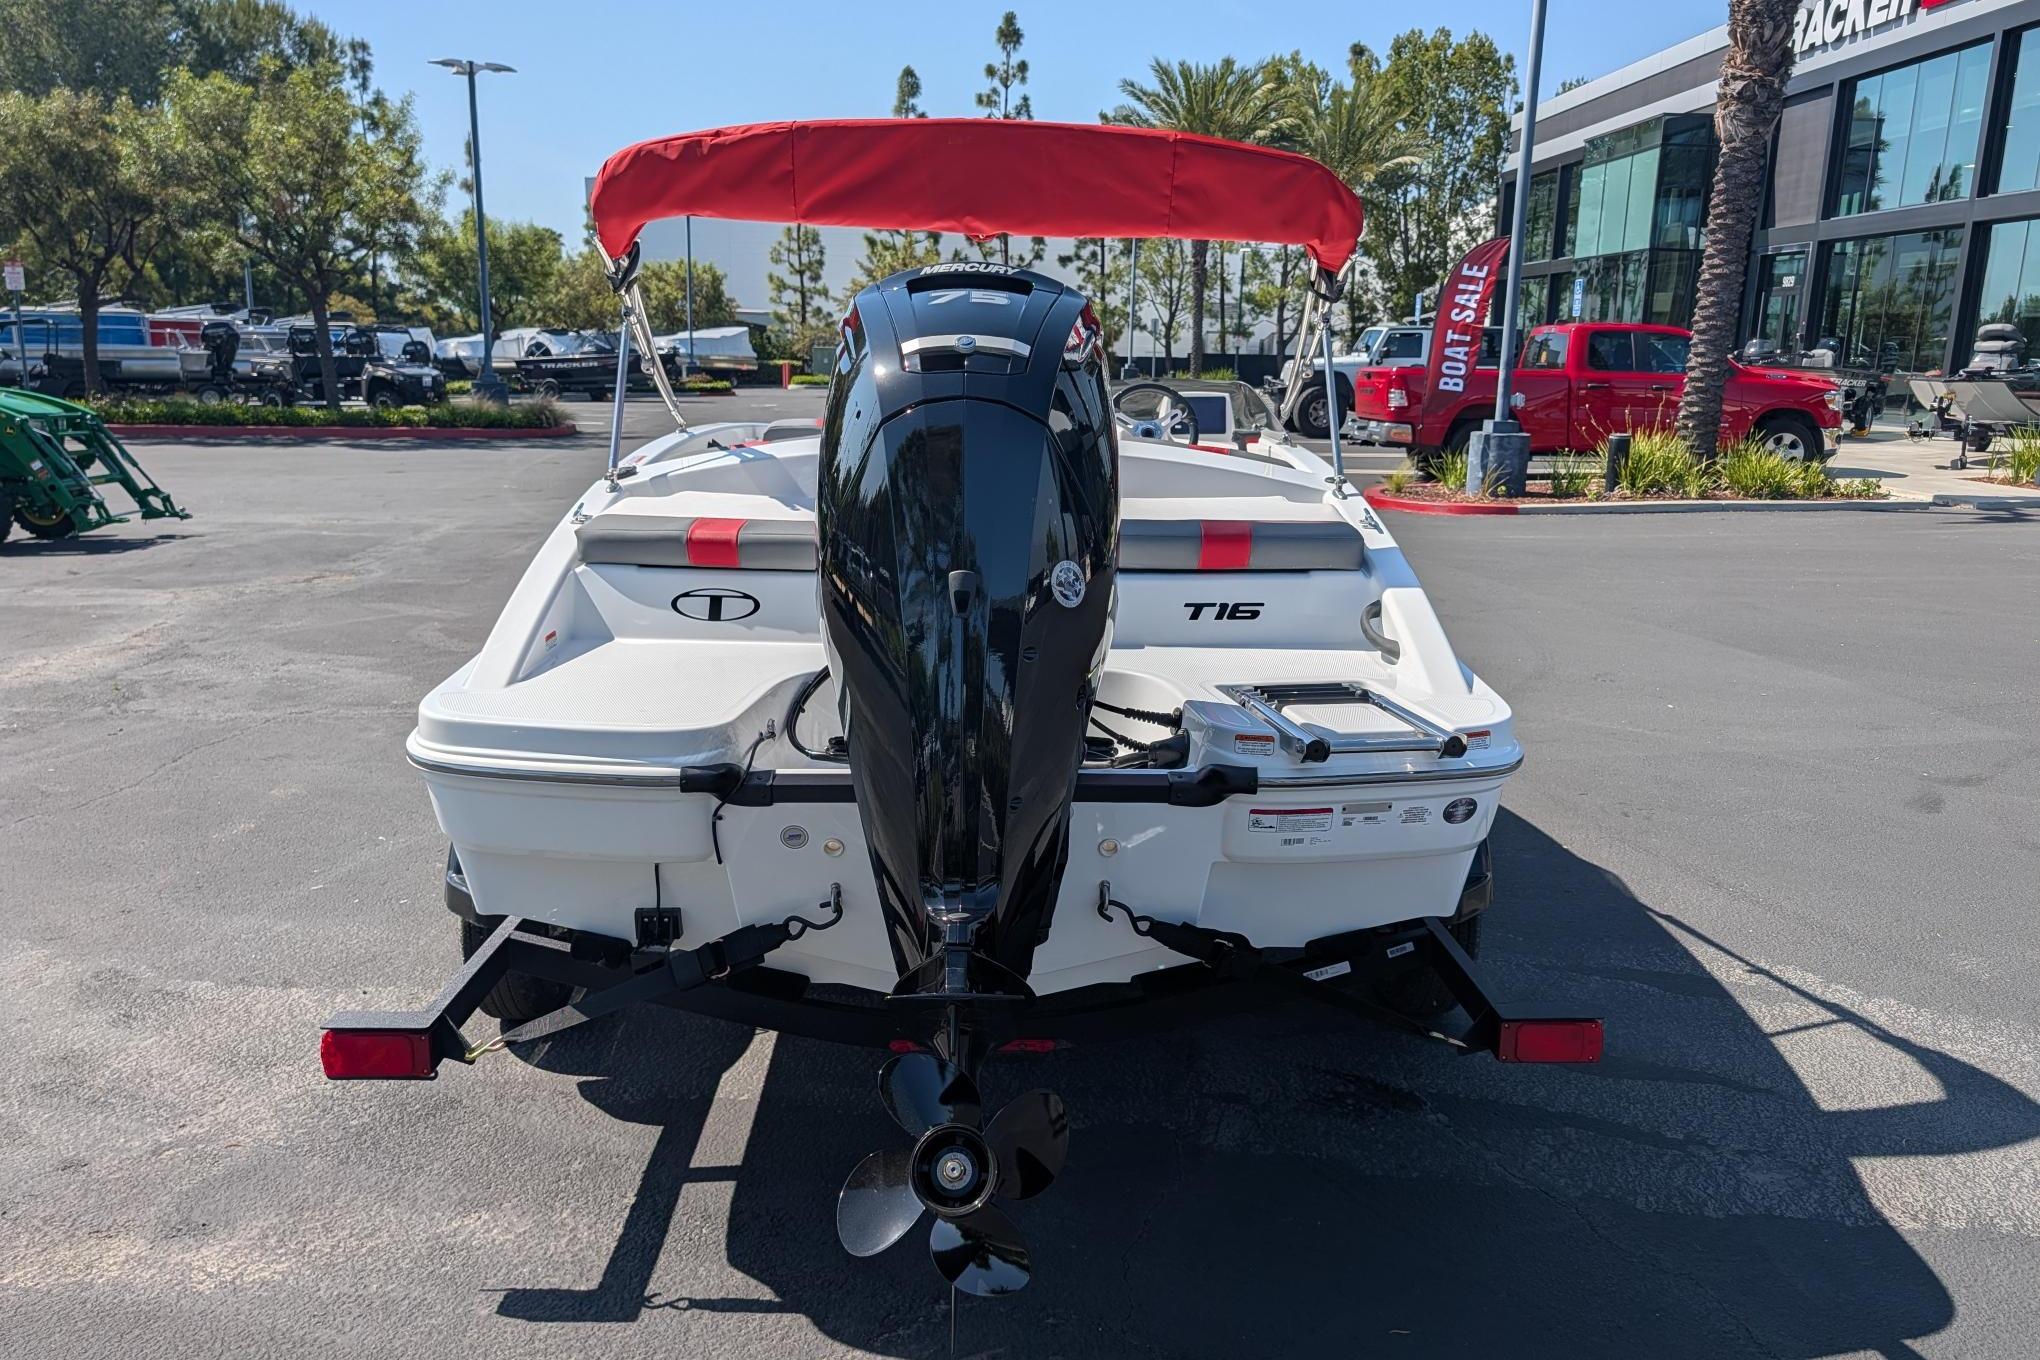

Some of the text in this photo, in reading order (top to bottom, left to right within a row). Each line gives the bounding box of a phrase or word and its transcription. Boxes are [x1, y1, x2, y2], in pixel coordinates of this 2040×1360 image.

[1788, 0, 1912, 54] RACKE
[920, 262, 1020, 275] MERCURY
[927, 289, 1012, 305] 75
[1438, 262, 1489, 393] BOAT SALE
[540, 361, 598, 369] TRACKER
[1183, 602, 1265, 621] T16
